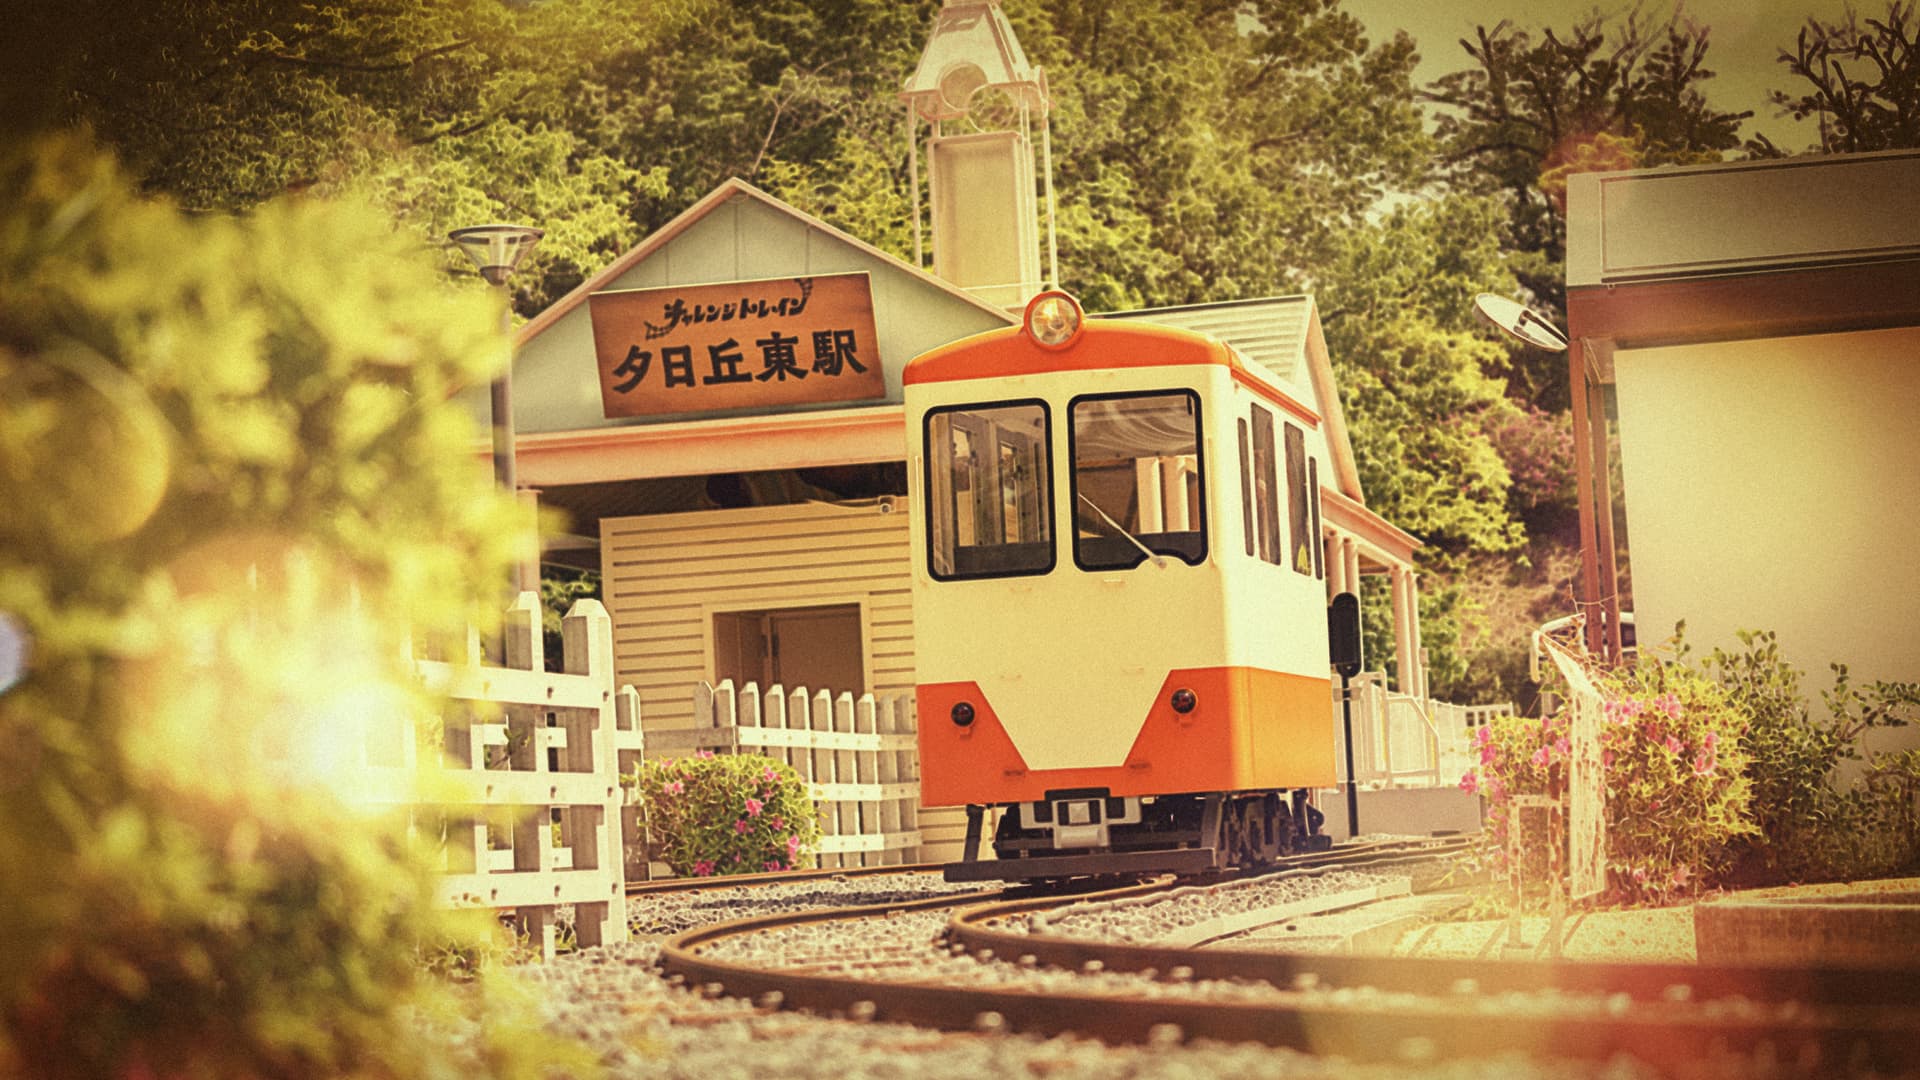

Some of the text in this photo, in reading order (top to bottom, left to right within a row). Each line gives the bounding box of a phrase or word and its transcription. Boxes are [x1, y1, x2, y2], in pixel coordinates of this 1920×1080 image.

[656, 292, 809, 328] チャレンジトレイン
[612, 329, 868, 394] 夕日丘東駅
